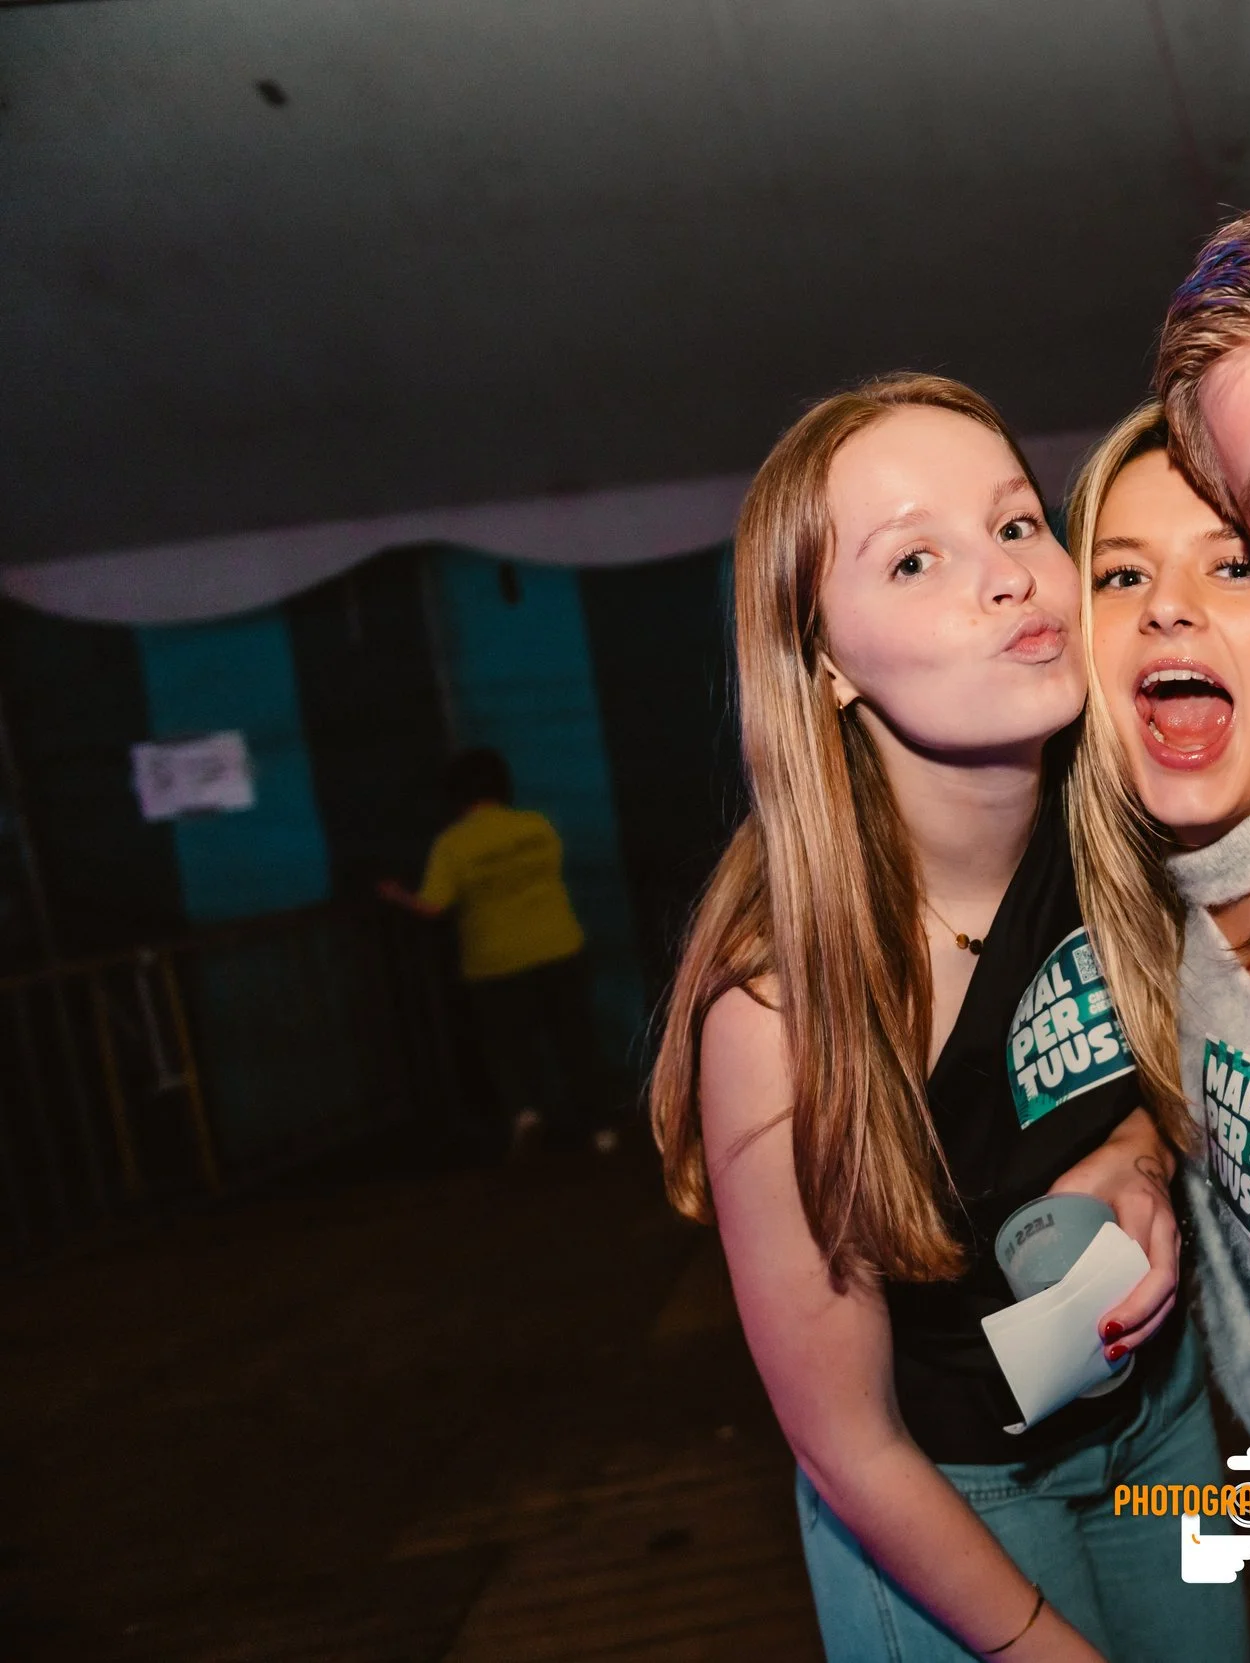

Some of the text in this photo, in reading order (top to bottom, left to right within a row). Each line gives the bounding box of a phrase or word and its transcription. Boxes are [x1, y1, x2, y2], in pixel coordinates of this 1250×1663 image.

[1013, 962, 1072, 1034] MAL
[1013, 998, 1084, 1071] PER
[1017, 1022, 1120, 1101] TUUS
[1206, 1094, 1248, 1165] PER
